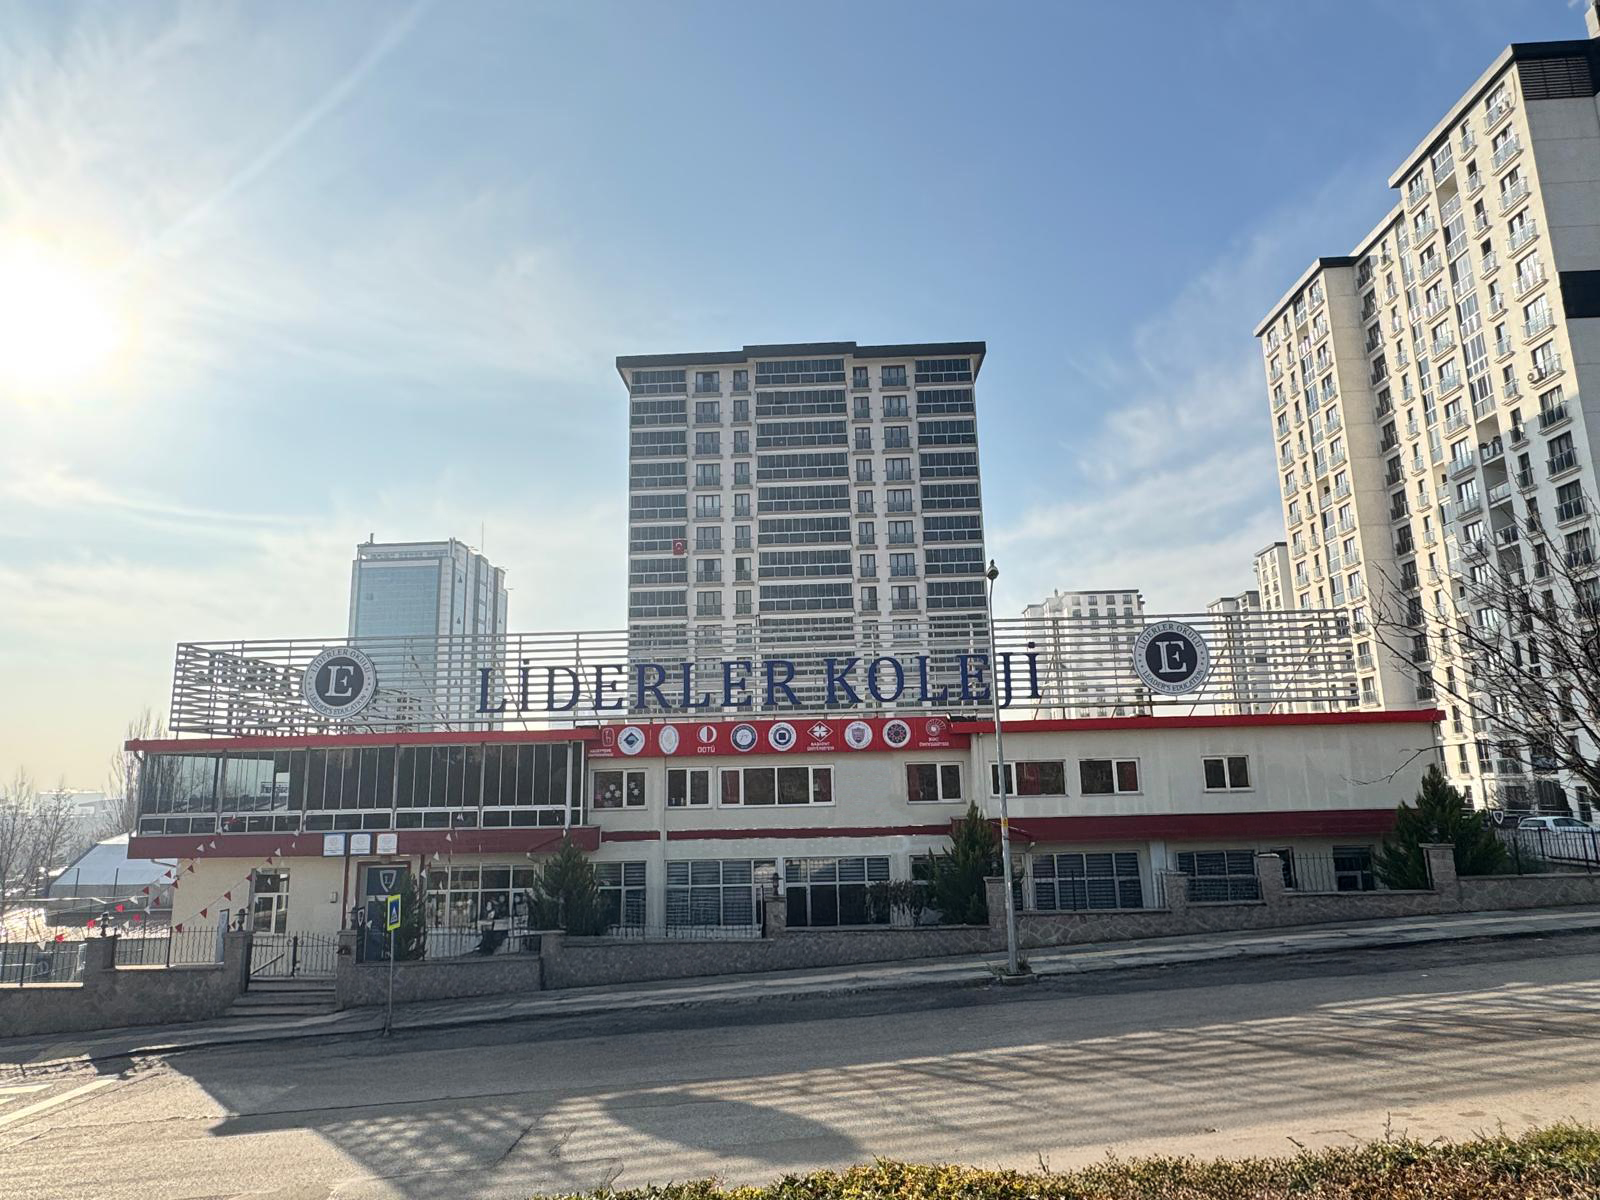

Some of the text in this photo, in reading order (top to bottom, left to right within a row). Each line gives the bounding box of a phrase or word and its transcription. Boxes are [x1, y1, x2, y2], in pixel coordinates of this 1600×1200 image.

[1176, 625, 1203, 648] OKULU
[350, 651, 372, 673] OKULU
[476, 642, 1042, 713] LİDERLER KOLEJİ
